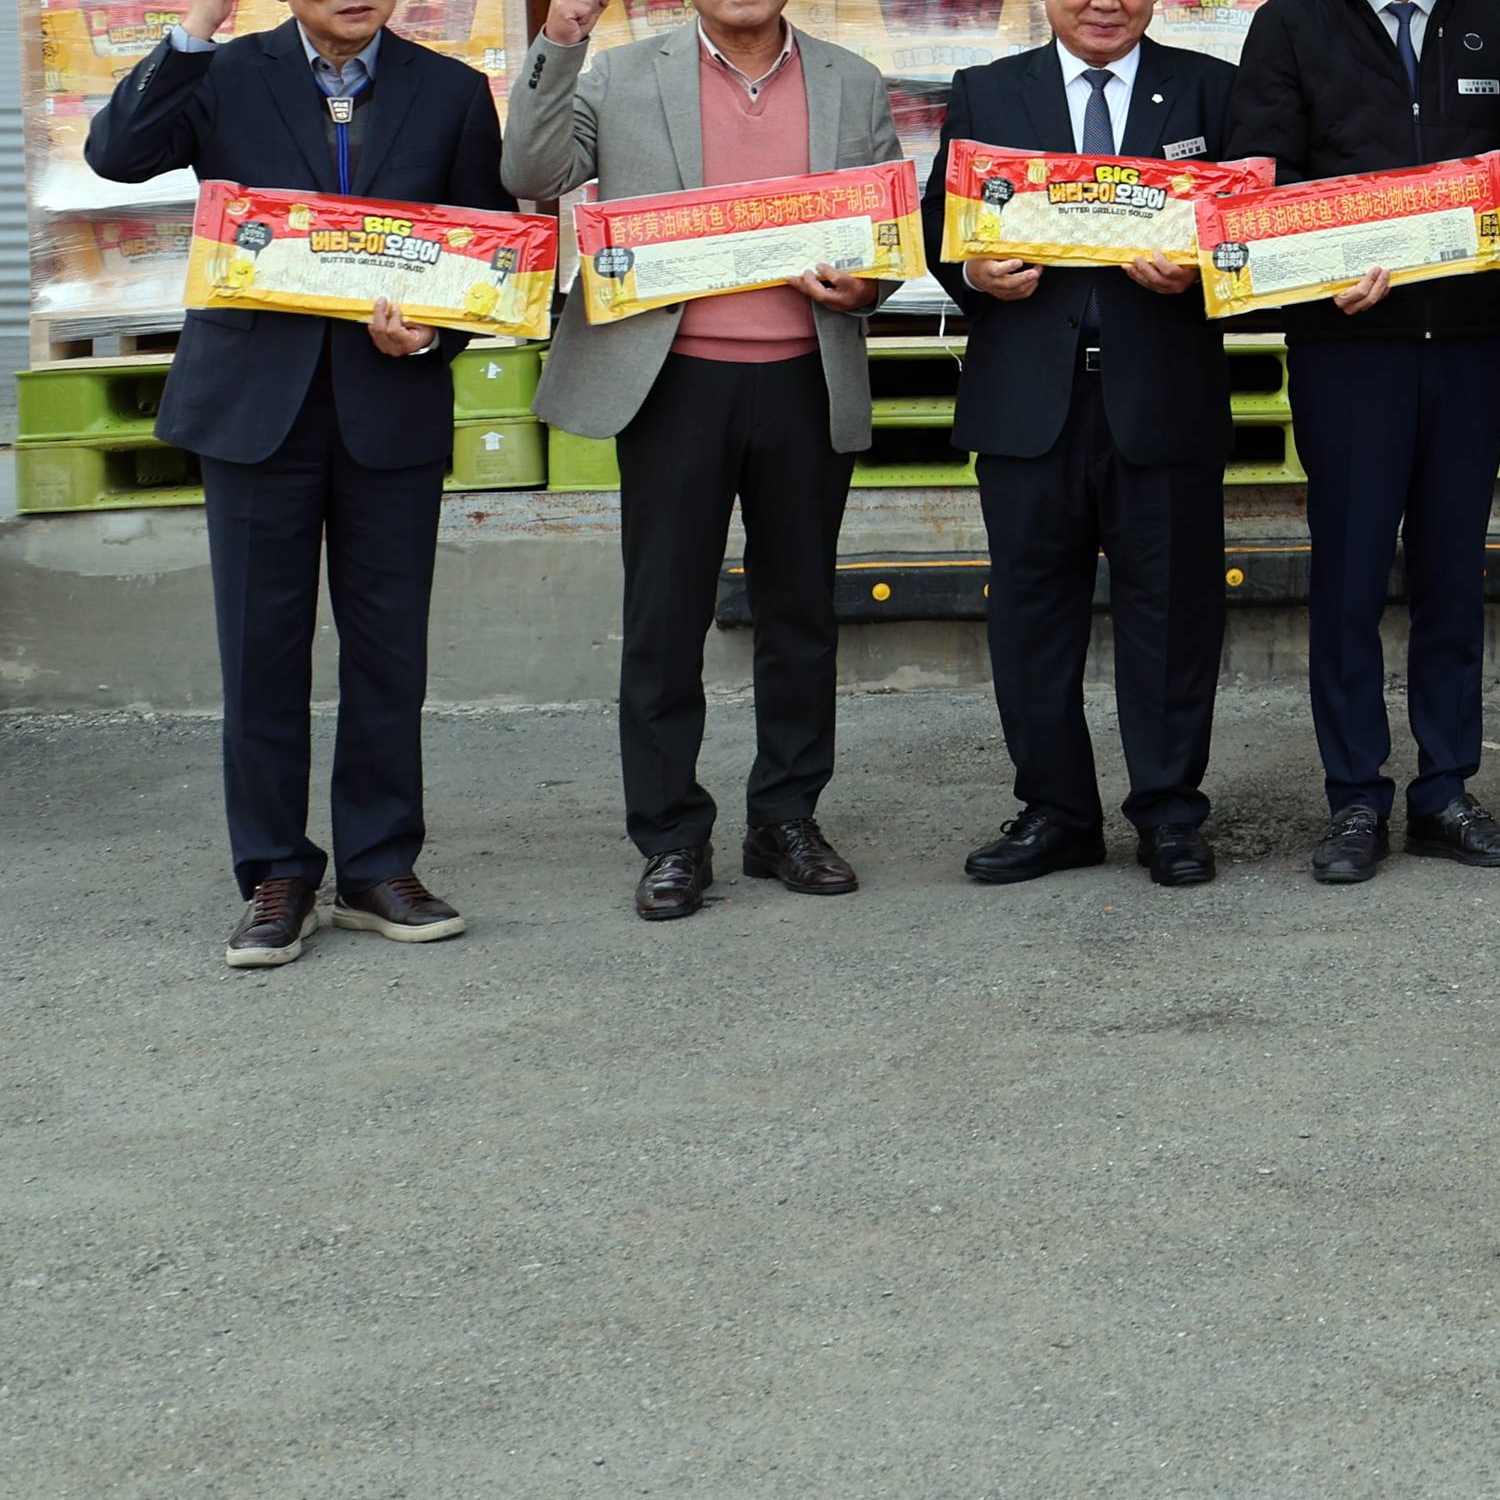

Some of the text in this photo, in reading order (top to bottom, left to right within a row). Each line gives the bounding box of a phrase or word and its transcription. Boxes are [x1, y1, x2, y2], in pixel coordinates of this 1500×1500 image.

[1095, 165, 1140, 184] BIG
[1047, 180, 1168, 211] 버터구이오징어
[362, 215, 414, 237] BIG
[309, 230, 441, 264] 버터구이오징어
